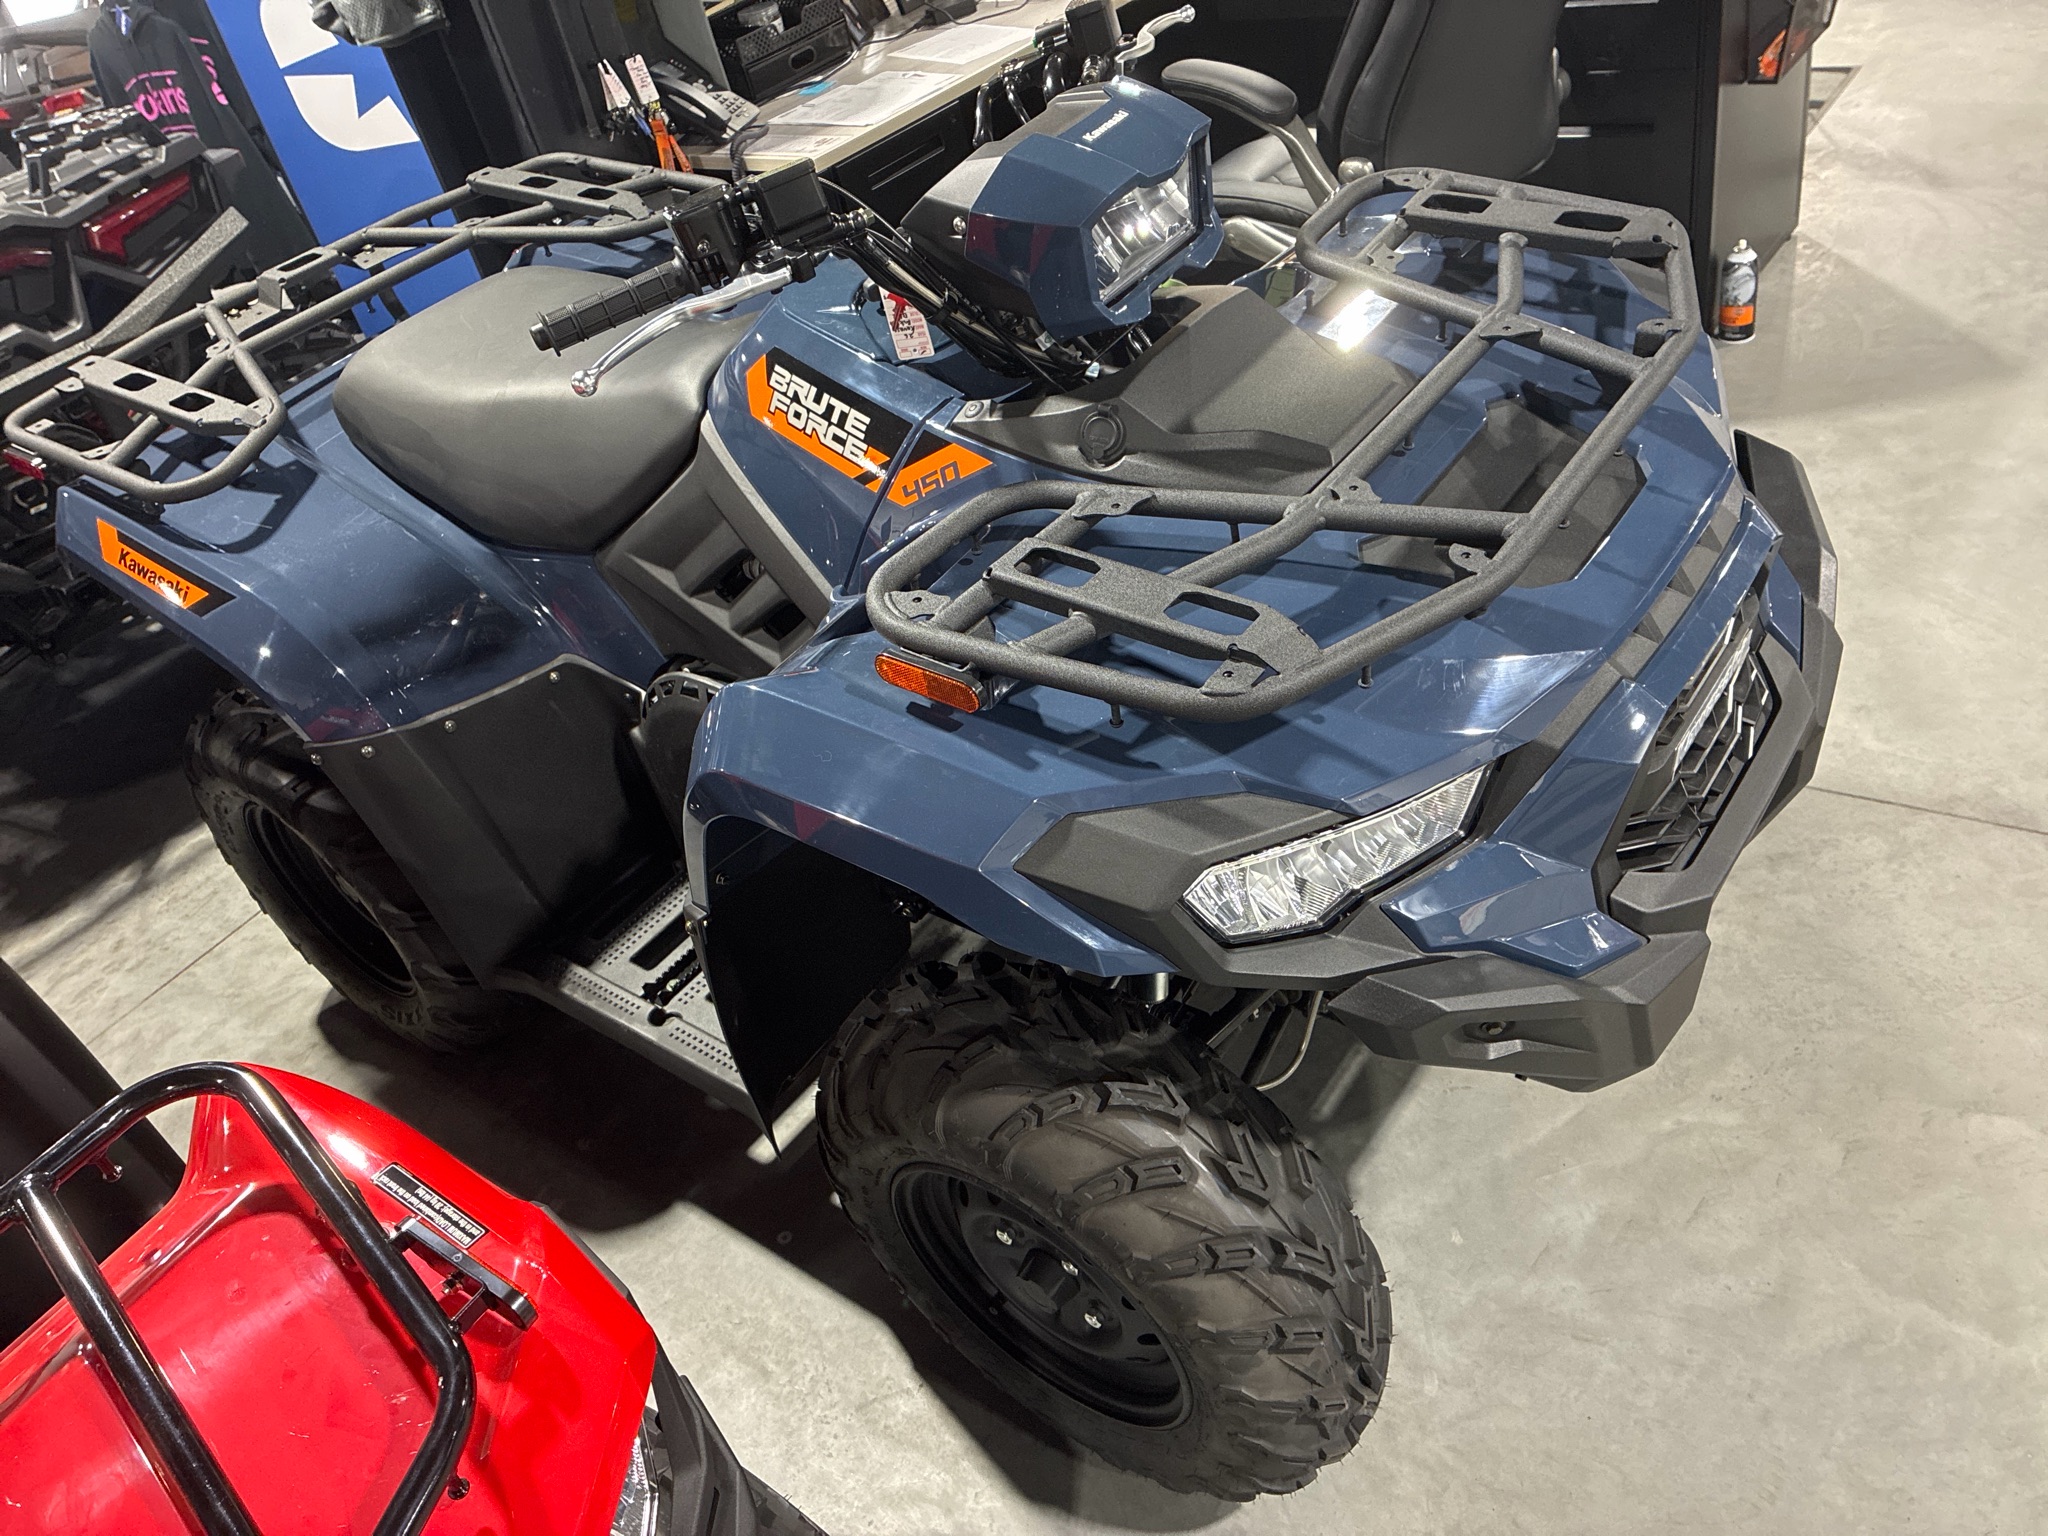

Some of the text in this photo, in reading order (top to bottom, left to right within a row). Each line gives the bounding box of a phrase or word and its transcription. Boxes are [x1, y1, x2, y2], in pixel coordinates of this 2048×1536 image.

[133, 77, 191, 121] olaris
[1082, 109, 1130, 142] Kawasaki
[768, 364, 871, 440] BRUTE
[768, 390, 870, 464] FORCE
[902, 461, 961, 498] 450
[446, 1224, 472, 1245] MAXIMUM
